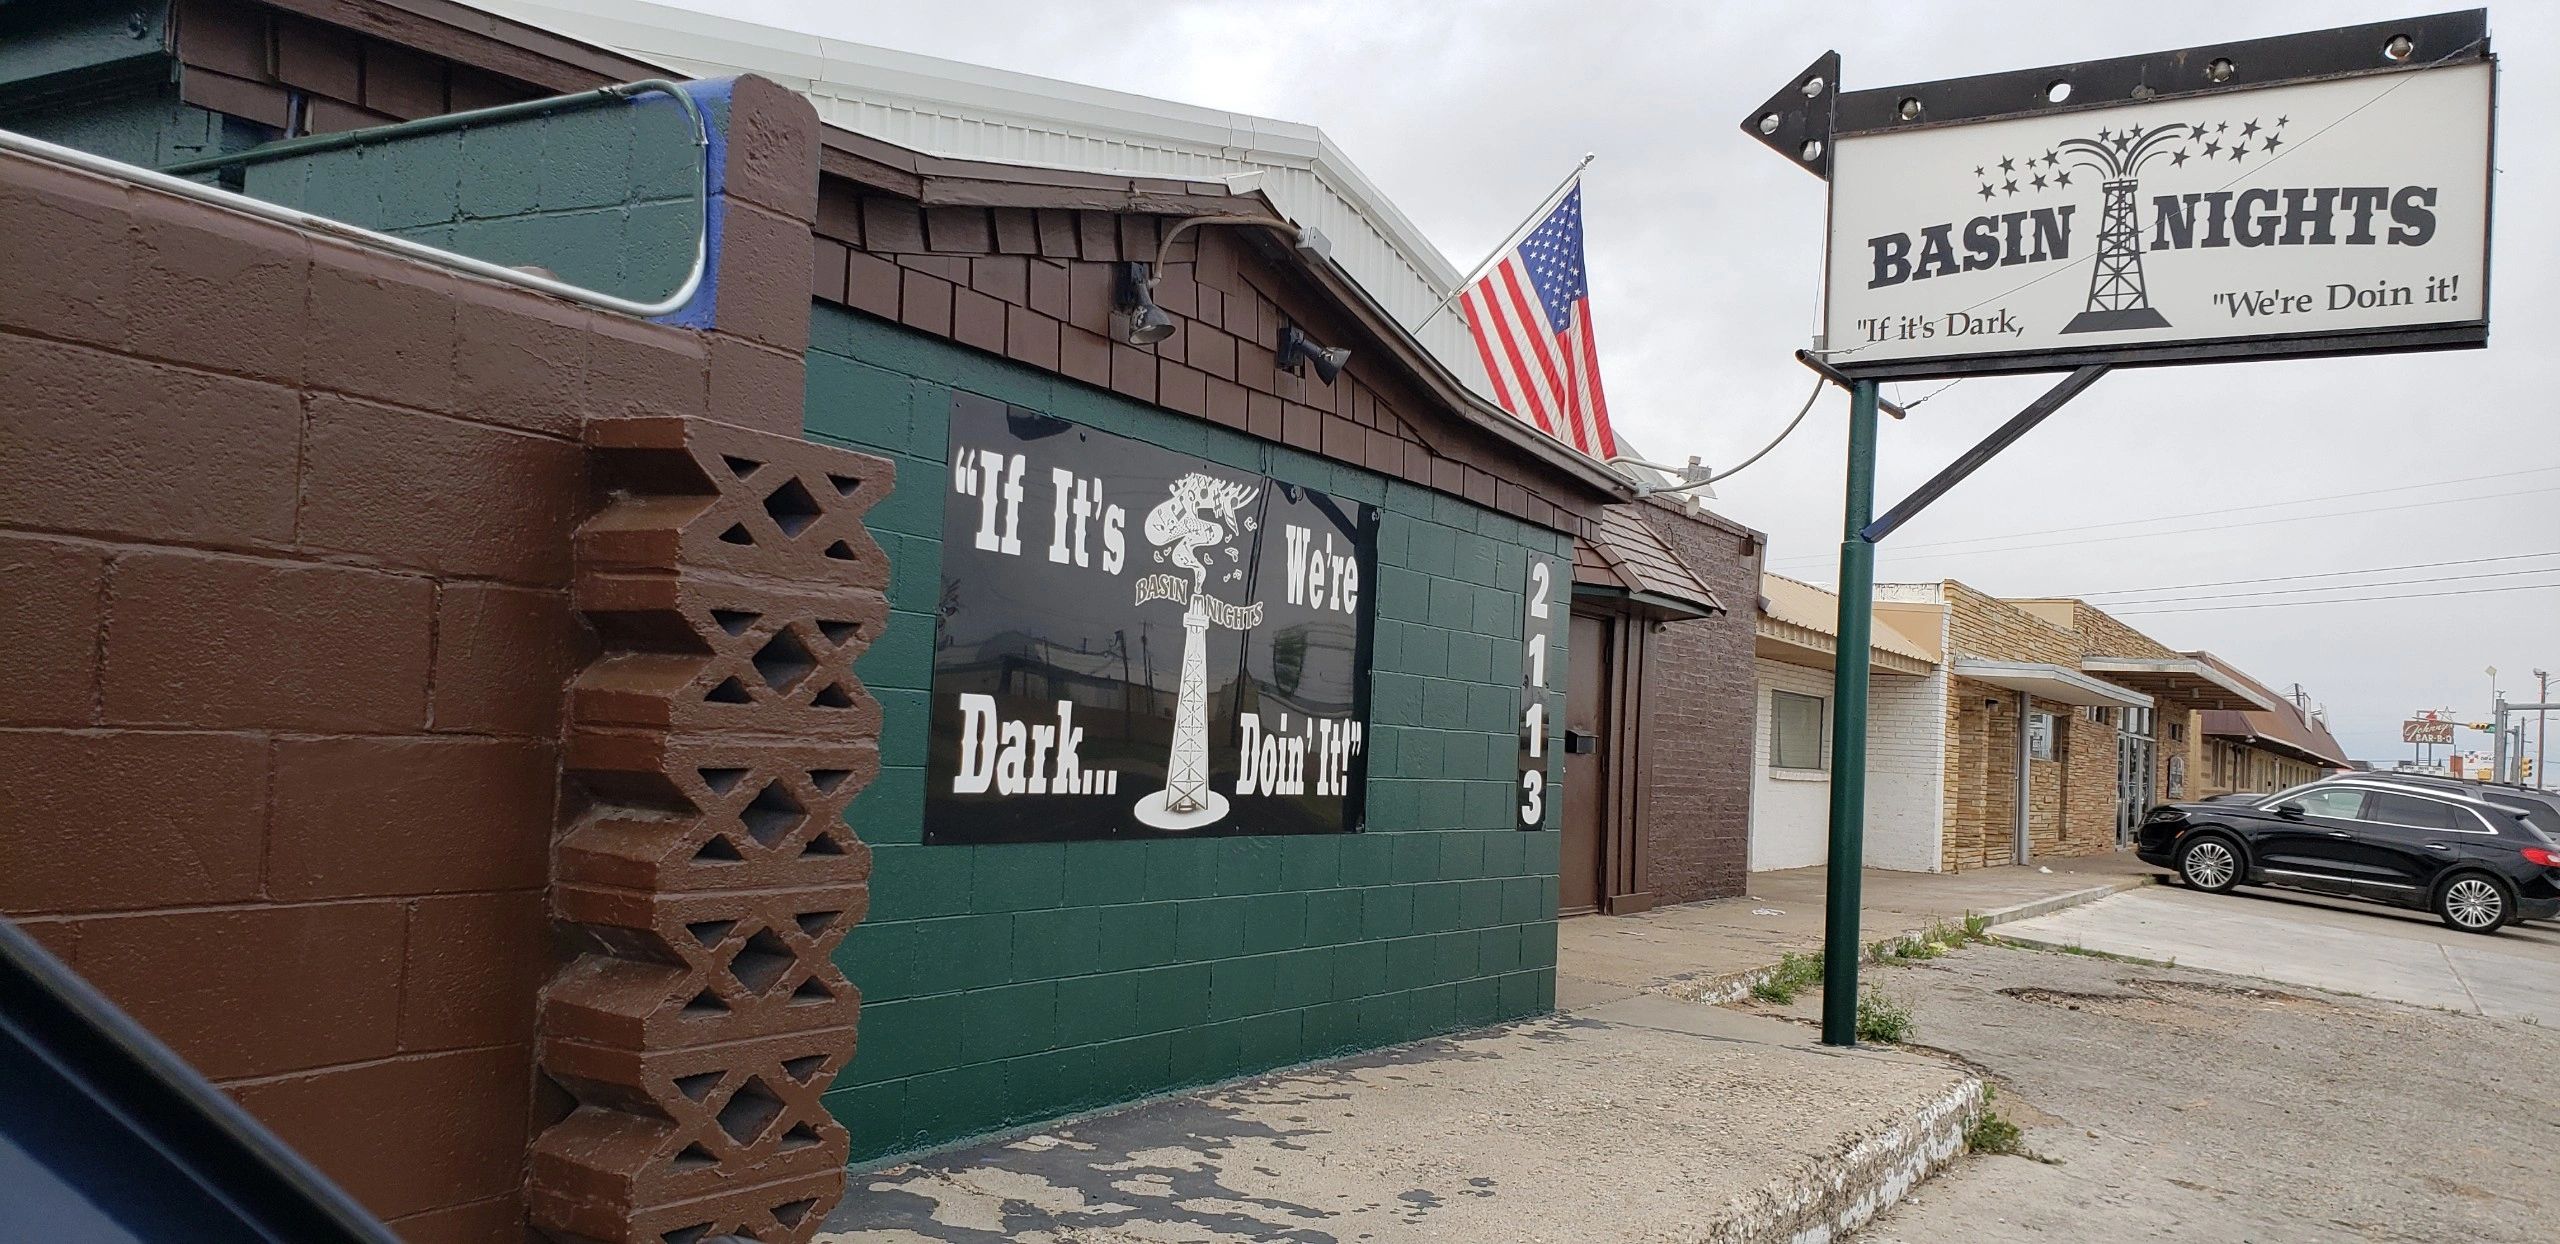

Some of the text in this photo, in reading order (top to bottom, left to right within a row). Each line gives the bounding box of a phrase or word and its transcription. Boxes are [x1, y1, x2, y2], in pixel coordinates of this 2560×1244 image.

[1867, 185, 2438, 290] BASIN NIGHTS
[1857, 308, 2024, 343] "If it's Dark,
[2325, 280, 2413, 311] Doin
[2425, 275, 2460, 304] it!
[1135, 574, 1264, 631] BASIN NIGHTS
[1521, 562, 1549, 825] 2113
[953, 693, 1118, 795] Dark...
